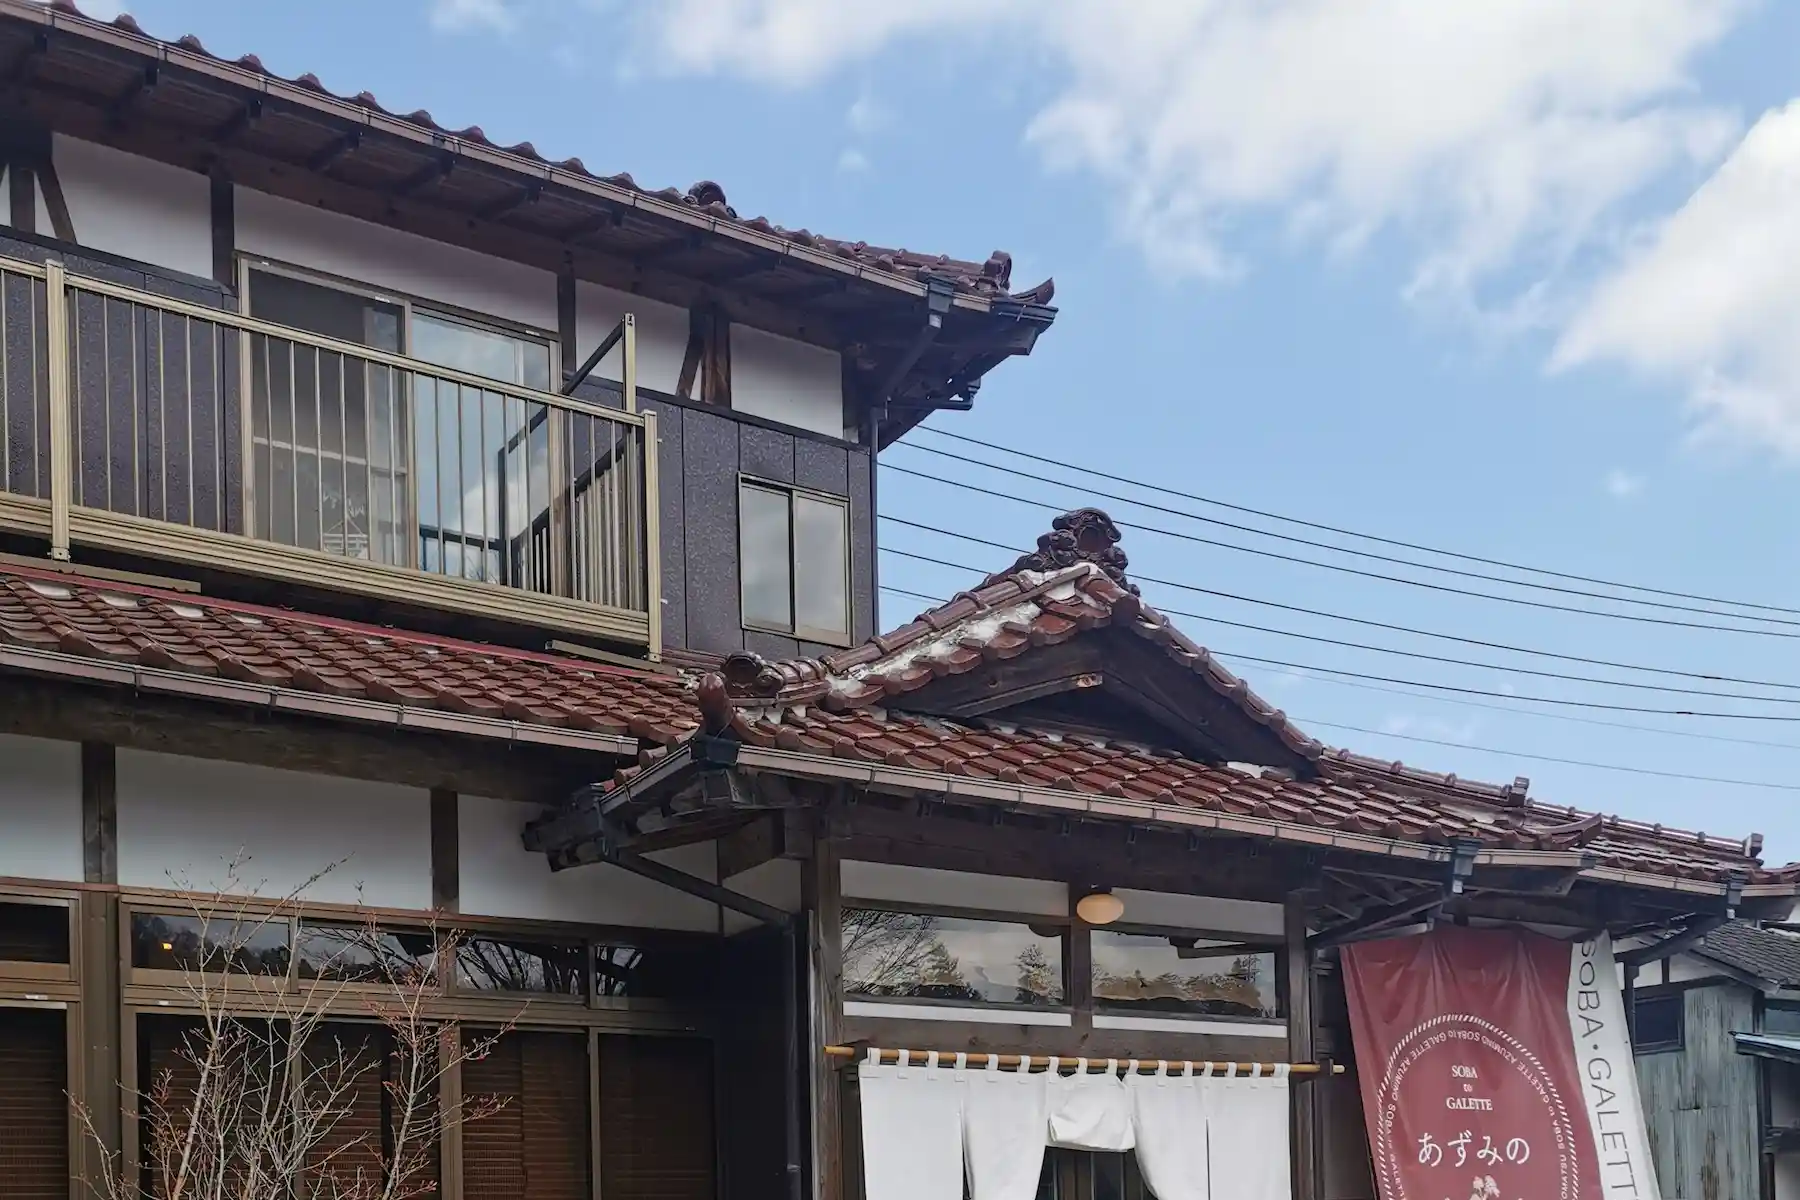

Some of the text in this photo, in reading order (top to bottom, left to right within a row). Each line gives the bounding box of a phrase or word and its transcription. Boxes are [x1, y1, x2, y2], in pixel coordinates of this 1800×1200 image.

[1410, 1032, 1447, 1060] GALETTE
[1392, 1057, 1411, 1101] AZUMINO
[1451, 1065, 1478, 1078] SOBA
[1446, 1097, 1493, 1111] GALETTE
[1418, 1130, 1530, 1167] あずみの
